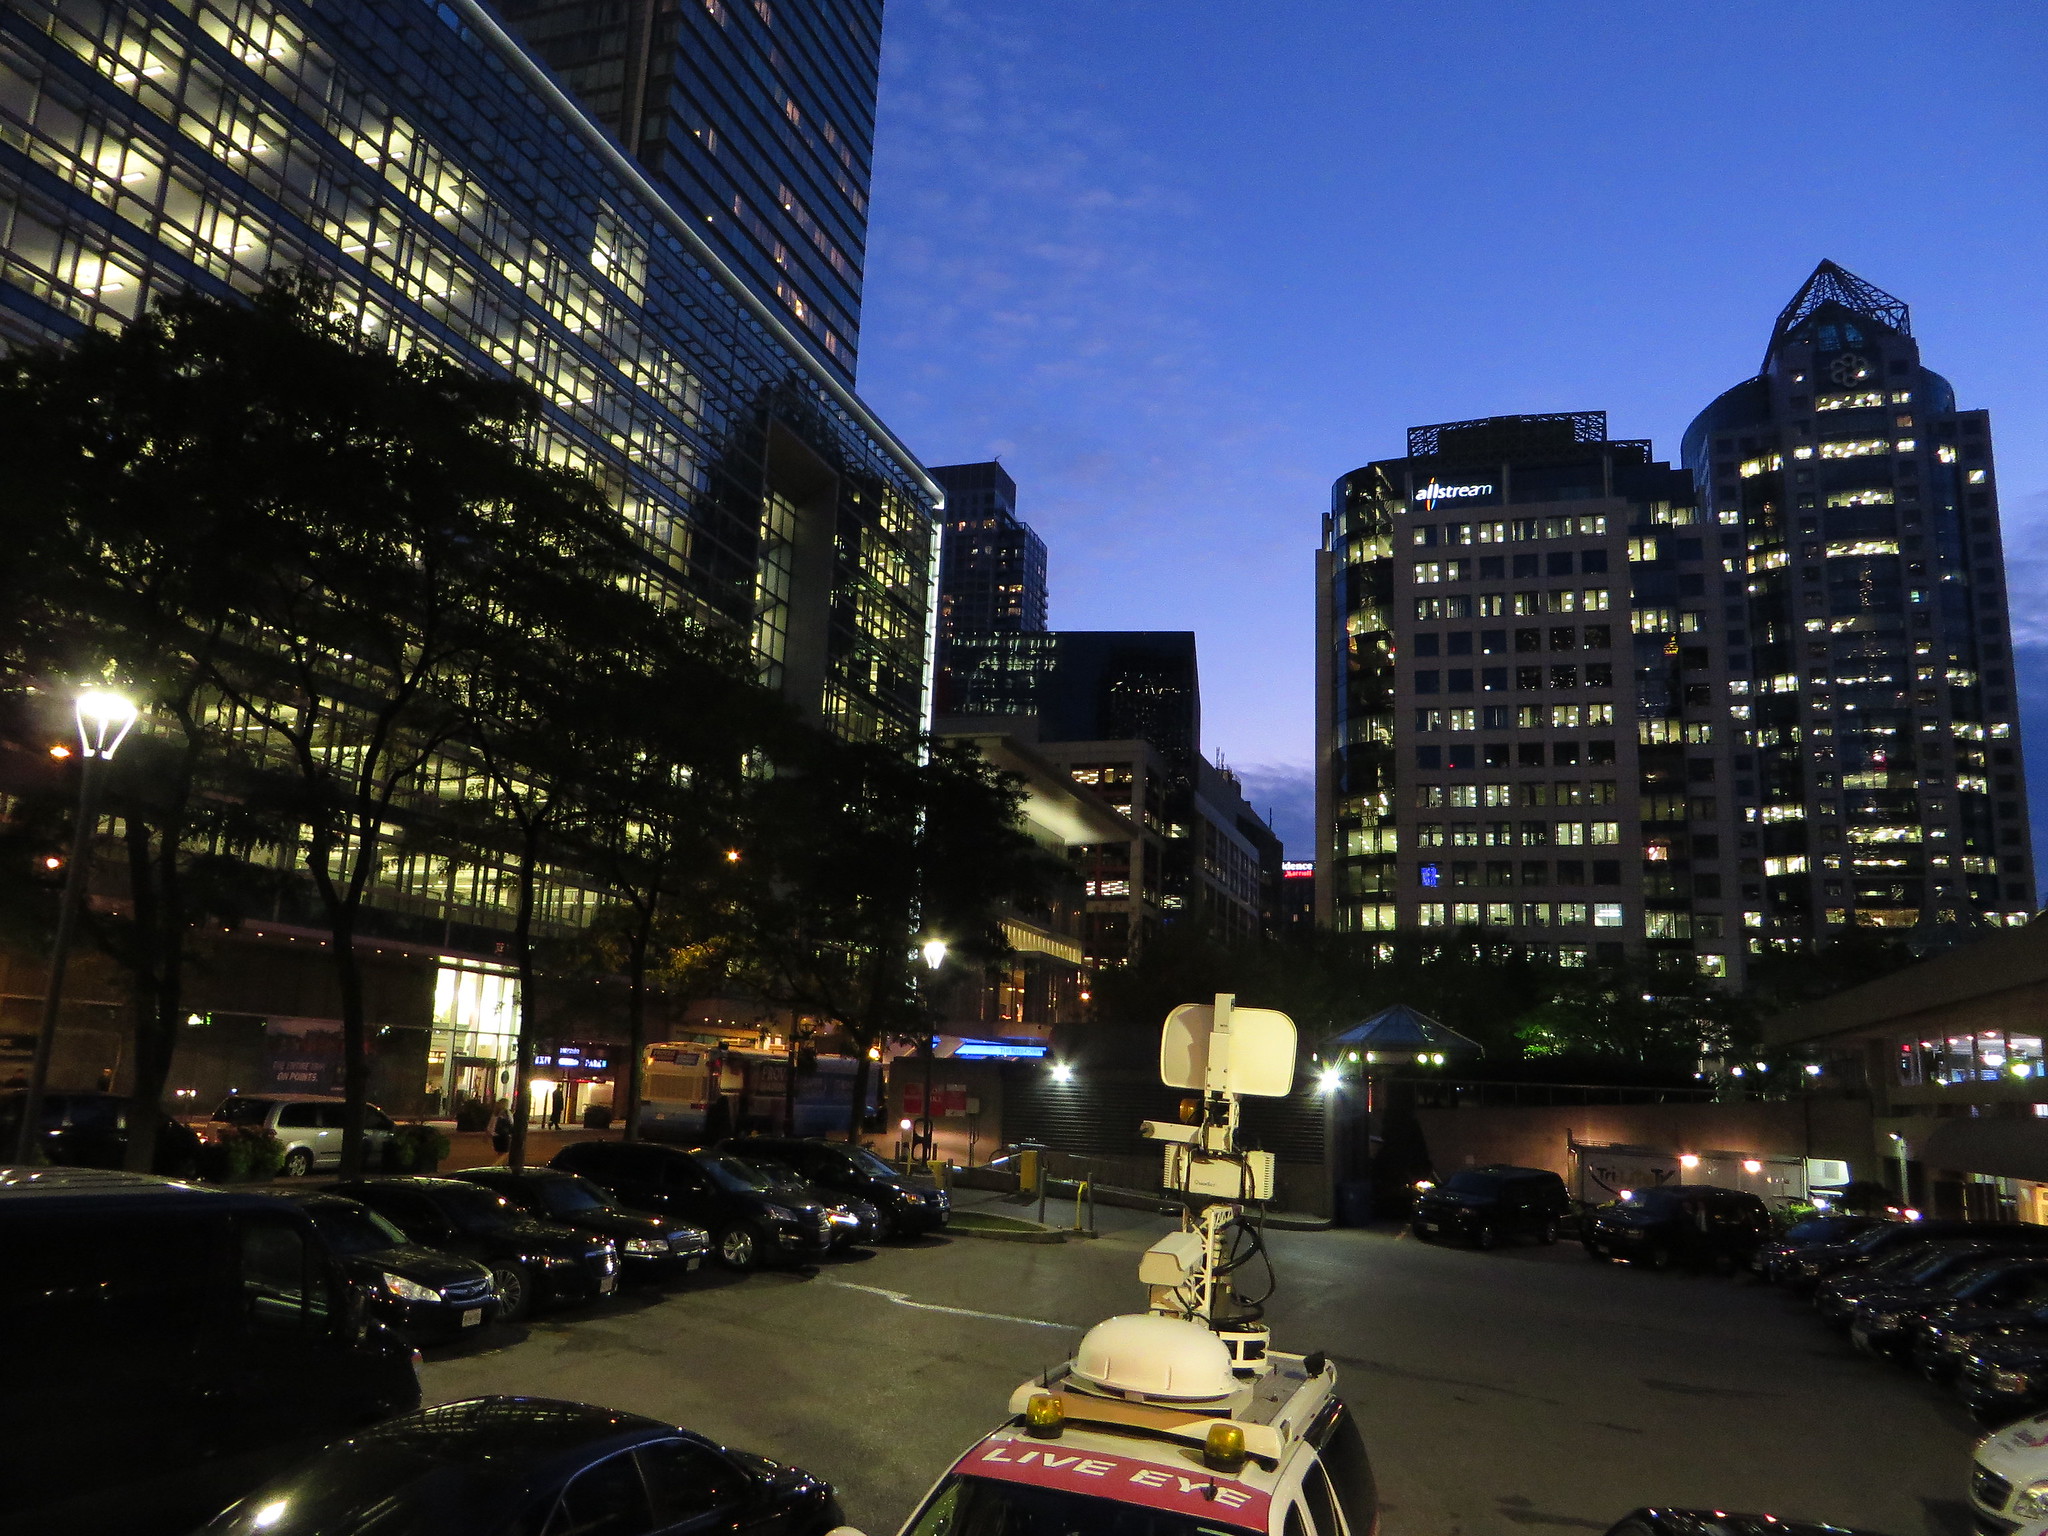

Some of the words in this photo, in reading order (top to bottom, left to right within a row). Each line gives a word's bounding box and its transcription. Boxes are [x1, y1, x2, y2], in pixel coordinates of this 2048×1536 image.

[1415, 482, 1493, 501] allstream
[981, 1448, 1118, 1476] LIVE
[1129, 1469, 1252, 1508] EYE
